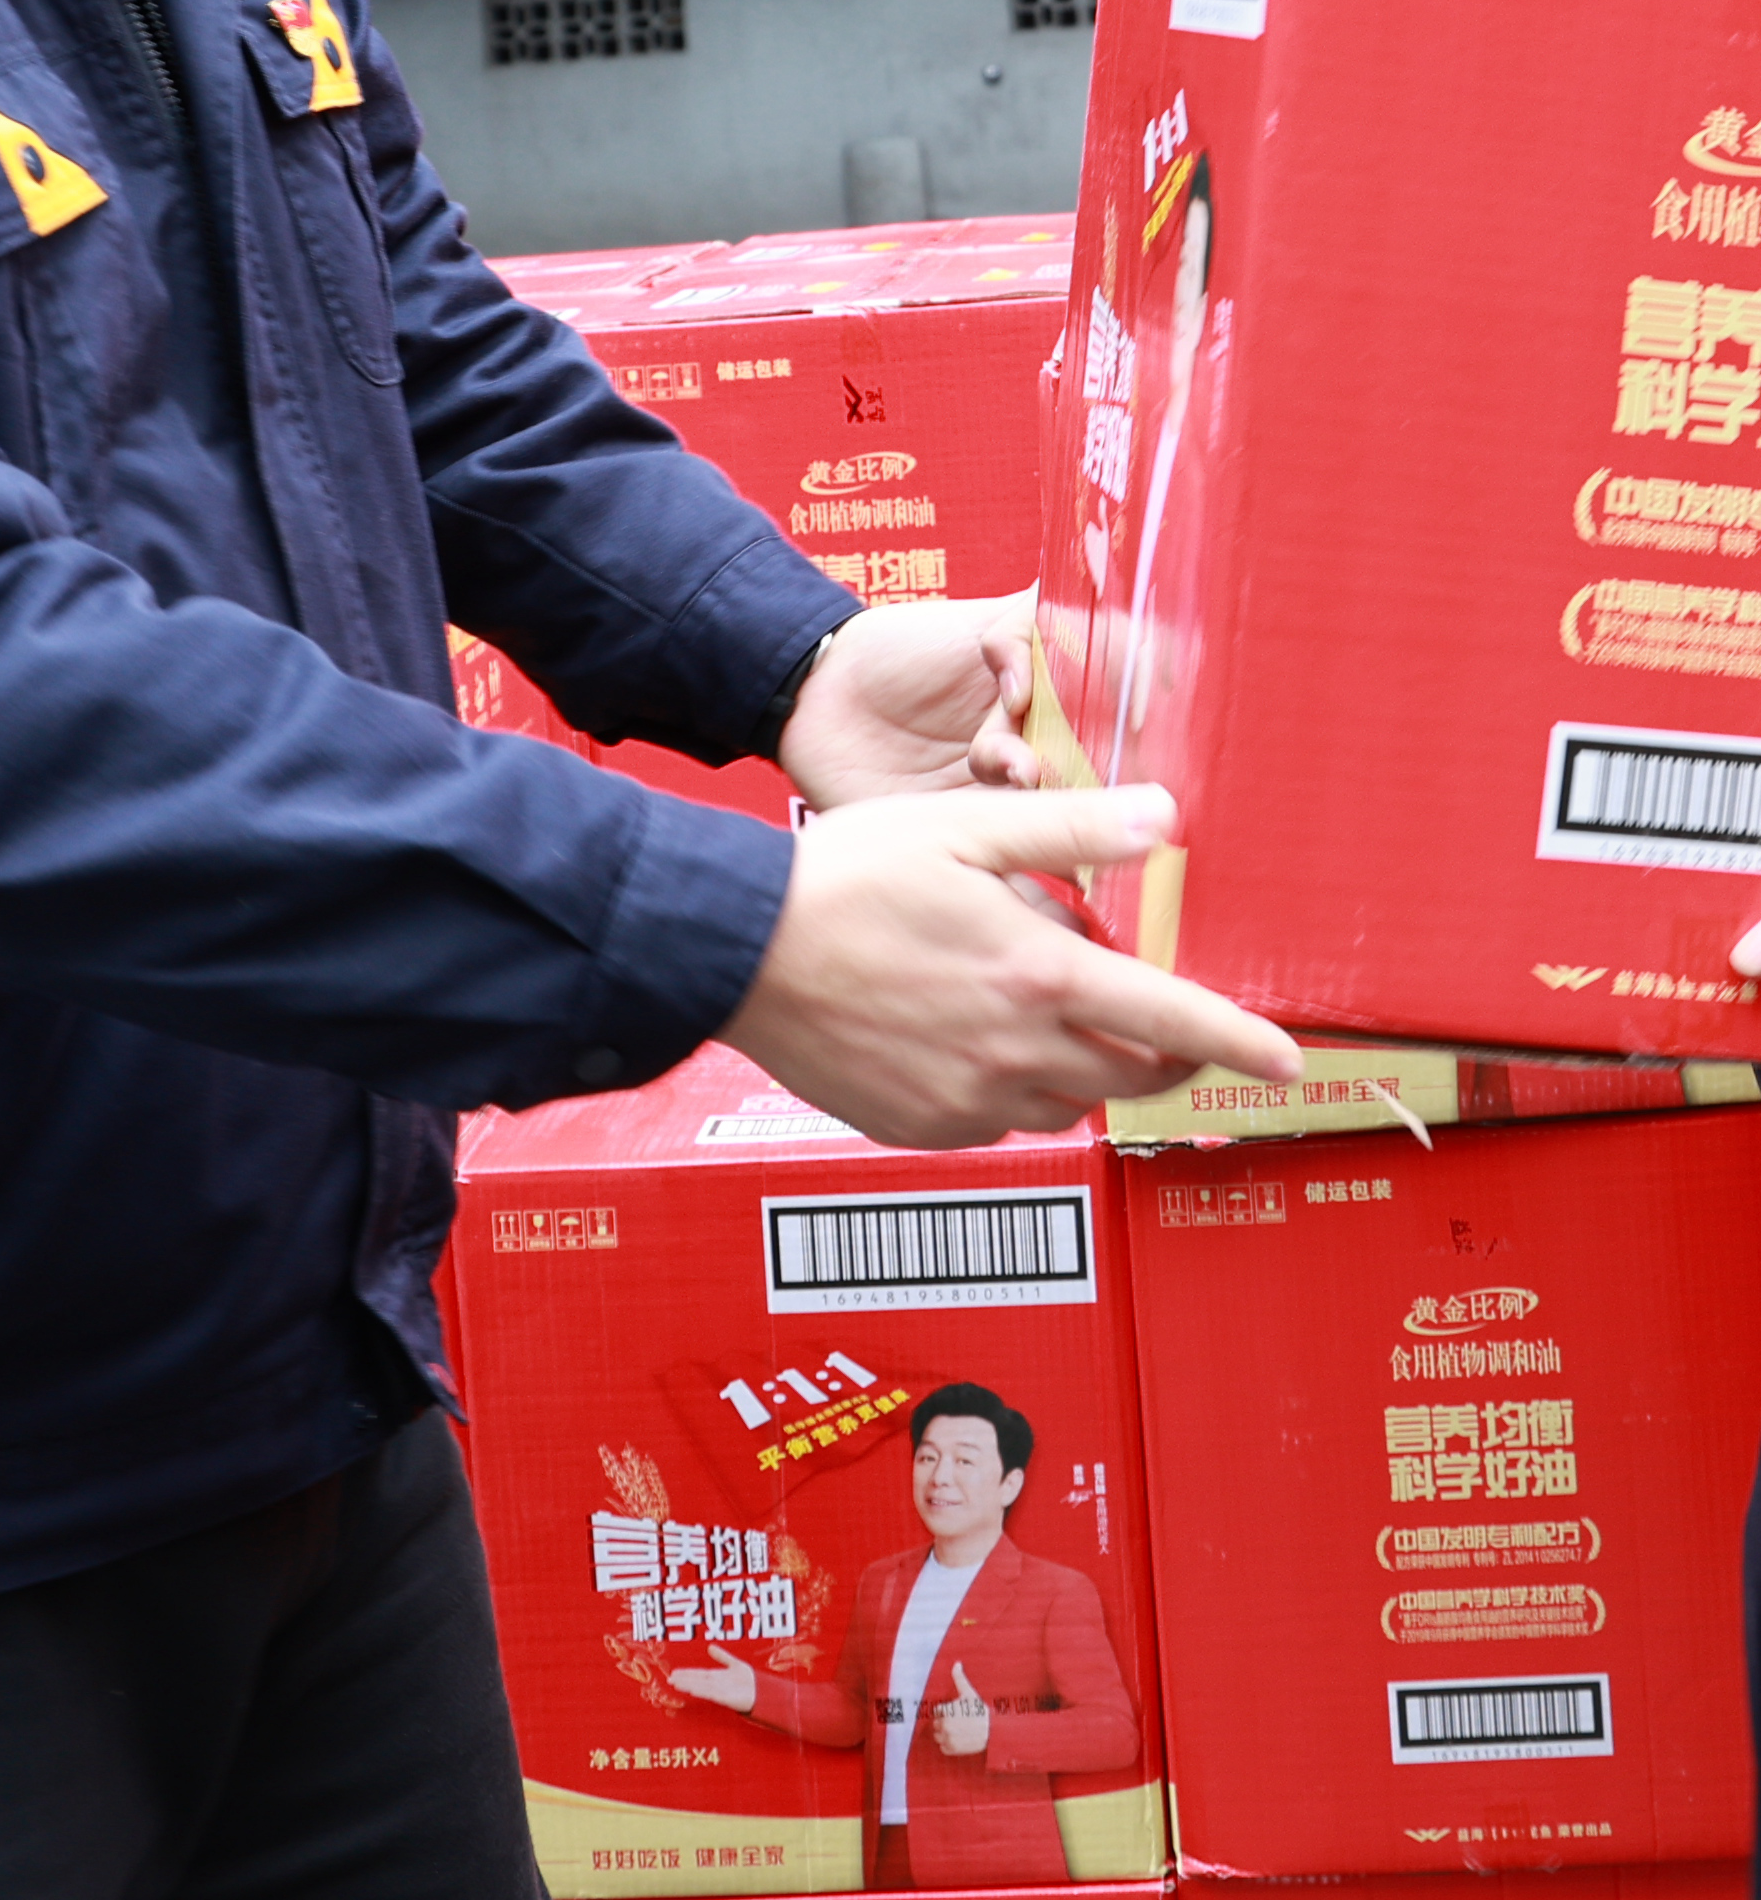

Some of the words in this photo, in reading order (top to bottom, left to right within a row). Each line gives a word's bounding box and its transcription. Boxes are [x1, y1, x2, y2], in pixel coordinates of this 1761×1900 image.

[716, 357, 792, 381] 储运包装
[806, 453, 906, 486] 黄金比例
[789, 496, 936, 535] 食用植物调和油
[1191, 1083, 1289, 1113] 好好吃饭
[1302, 1077, 1401, 1106] 健康全家
[1305, 1179, 1393, 1204] 储运包装
[821, 1286, 1042, 1305] 16948195800511
[1412, 1292, 1528, 1326] 黄金比例
[1388, 1340, 1562, 1381] 食用植物调和油
[719, 1350, 878, 1430] 1:1:1
[757, 1387, 911, 1472] 平衡营养更健康
[1384, 1398, 1574, 1452] 营养均衡
[1388, 1449, 1579, 1502] 科学好油
[591, 1509, 769, 1595] 营养均衡
[1394, 1521, 1581, 1553] 中国发明专利配方
[631, 1574, 797, 1644] 科学好油
[1398, 1584, 1586, 1611] 中国营养学科学技术奖
[589, 1746, 721, 1771] 净含量:5升X4
[1558, 1821, 1613, 1839] 荣誉出品
[592, 1848, 682, 1871] 好好吃饭
[695, 1846, 785, 1869] 健康全家
